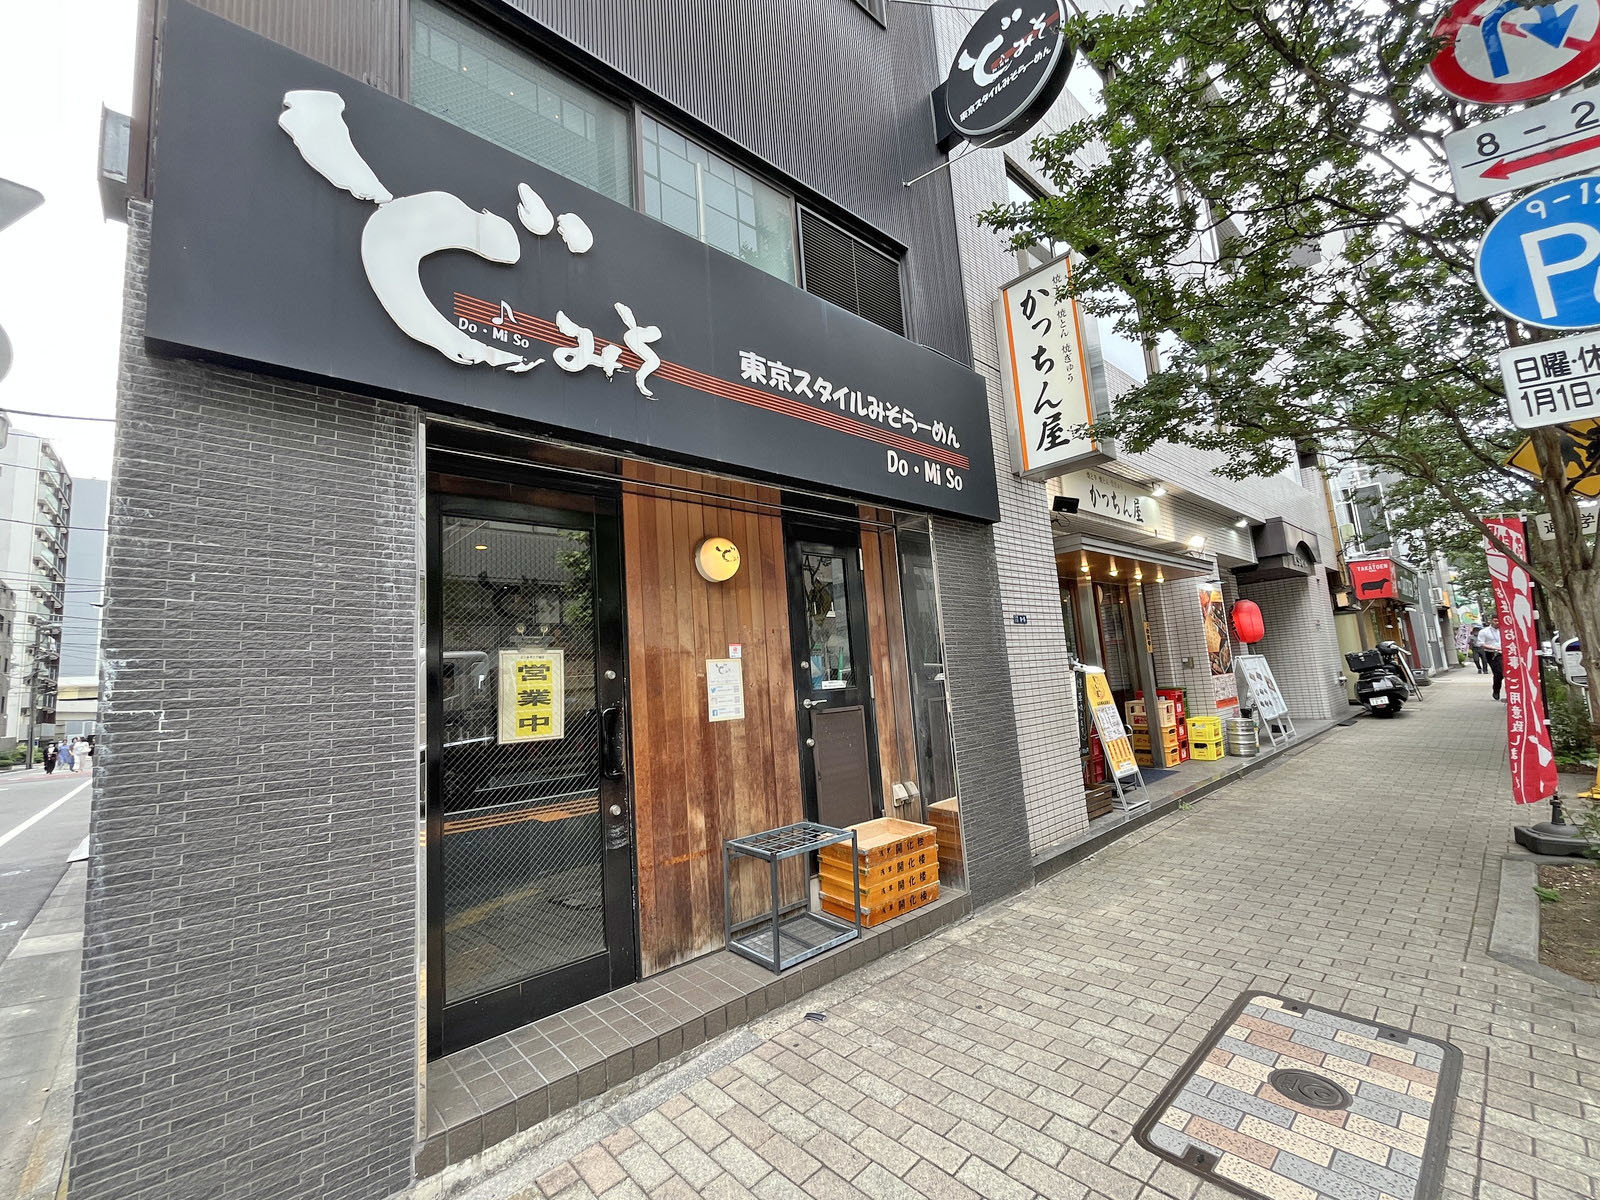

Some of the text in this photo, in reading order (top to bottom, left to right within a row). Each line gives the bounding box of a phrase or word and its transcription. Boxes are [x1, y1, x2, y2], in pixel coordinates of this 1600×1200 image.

[458, 317, 477, 333] Do
[492, 327, 508, 342] Mi
[512, 334, 529, 348] So
[739, 350, 960, 448] 東京スタイルみそらーめん
[887, 450, 908, 476] Do
[925, 461, 941, 486] Mi
[946, 468, 963, 491] So
[517, 664, 551, 732] 営業中
